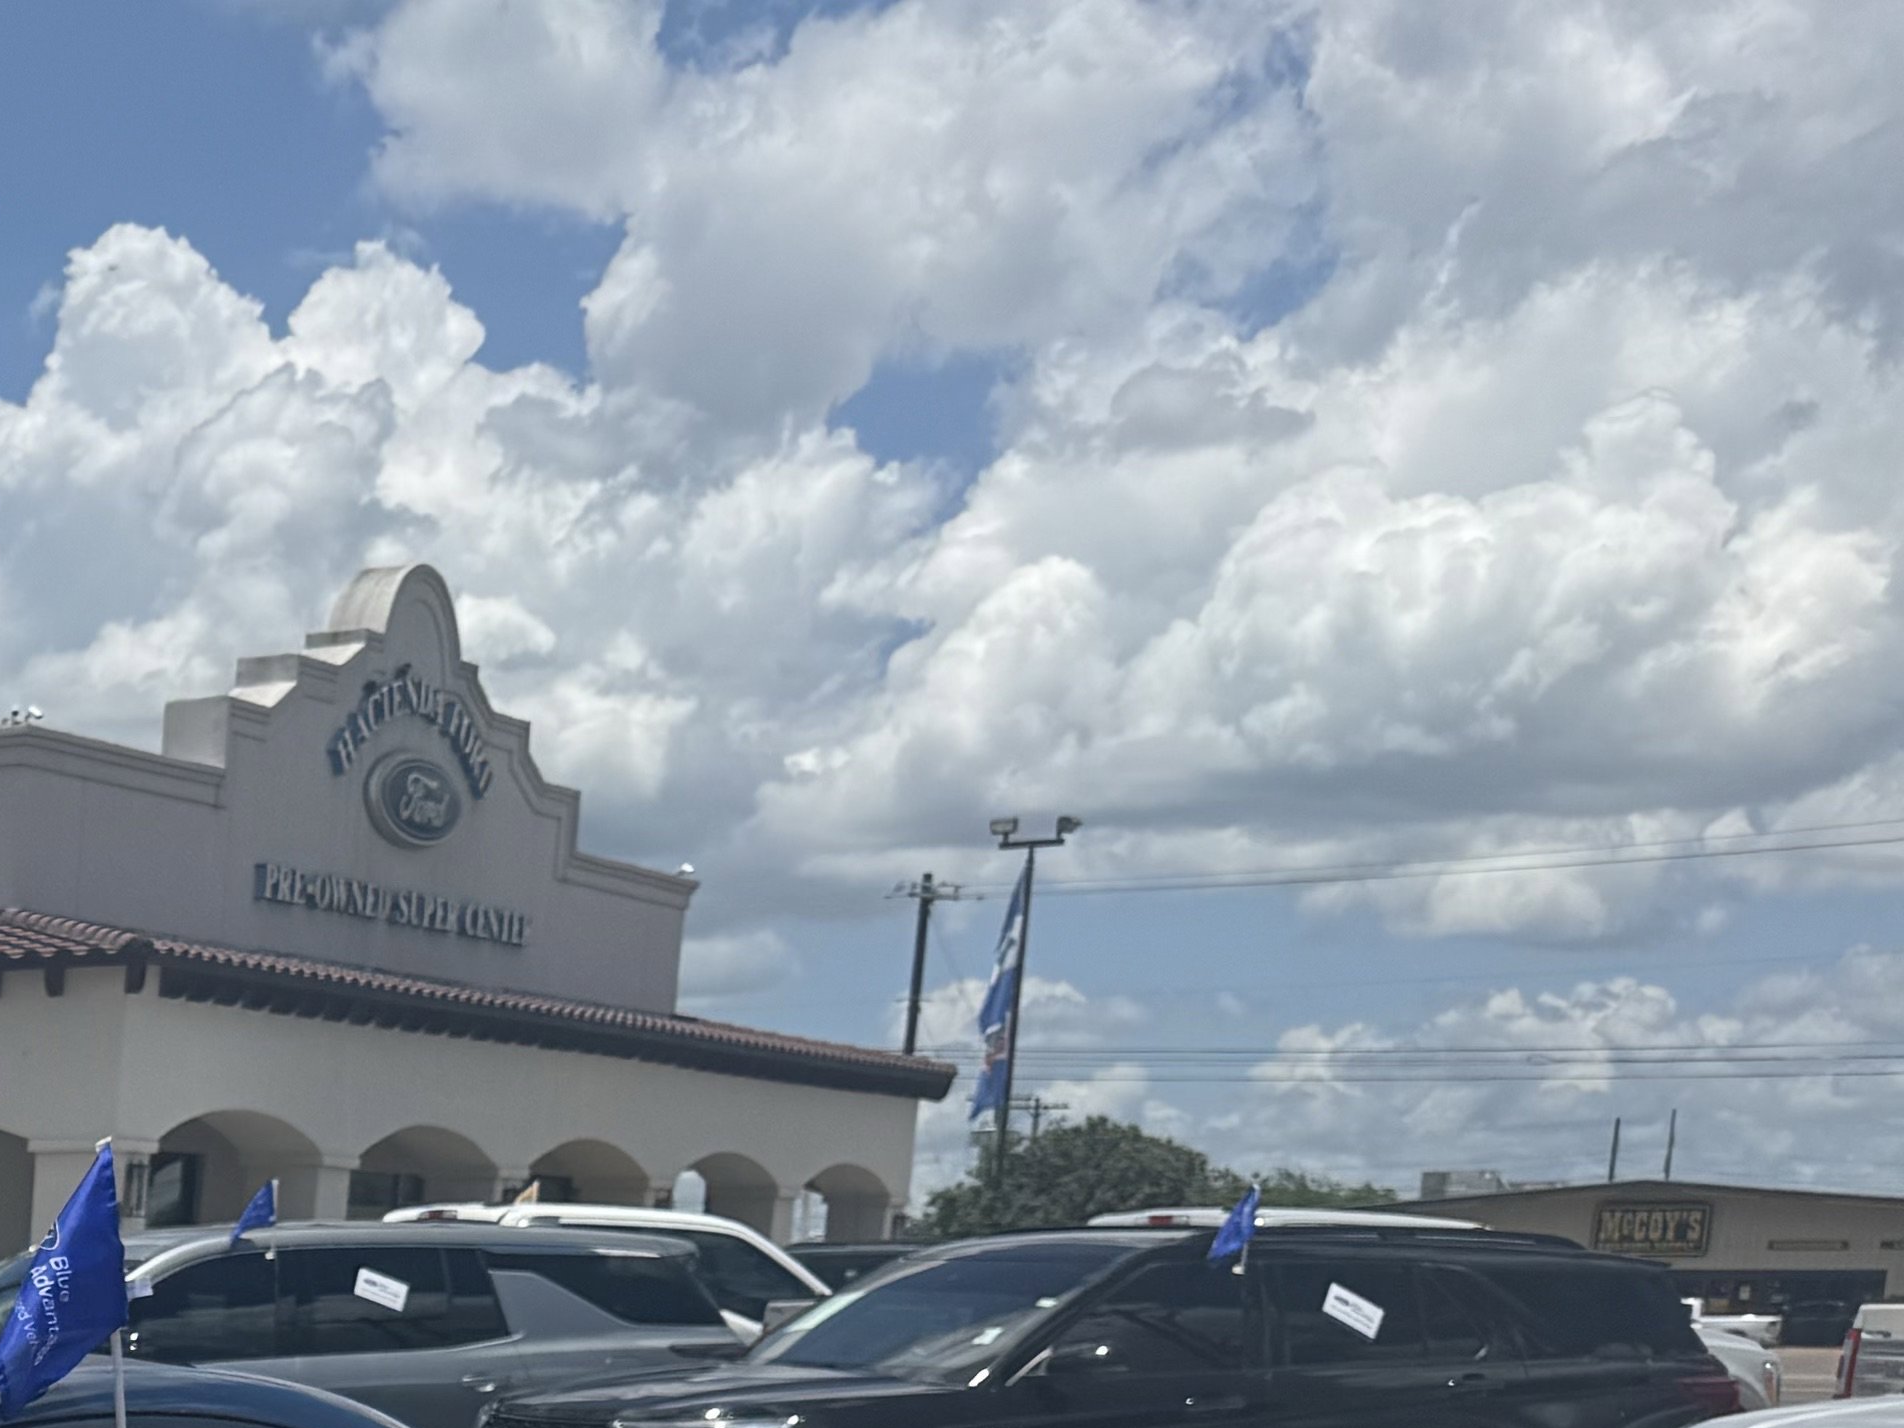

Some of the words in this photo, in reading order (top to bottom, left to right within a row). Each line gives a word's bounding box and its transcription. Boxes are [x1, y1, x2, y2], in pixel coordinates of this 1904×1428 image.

[264, 863, 392, 921] PRE-OWNED
[398, 889, 458, 932] SUPER
[49, 1255, 72, 1303] Blue
